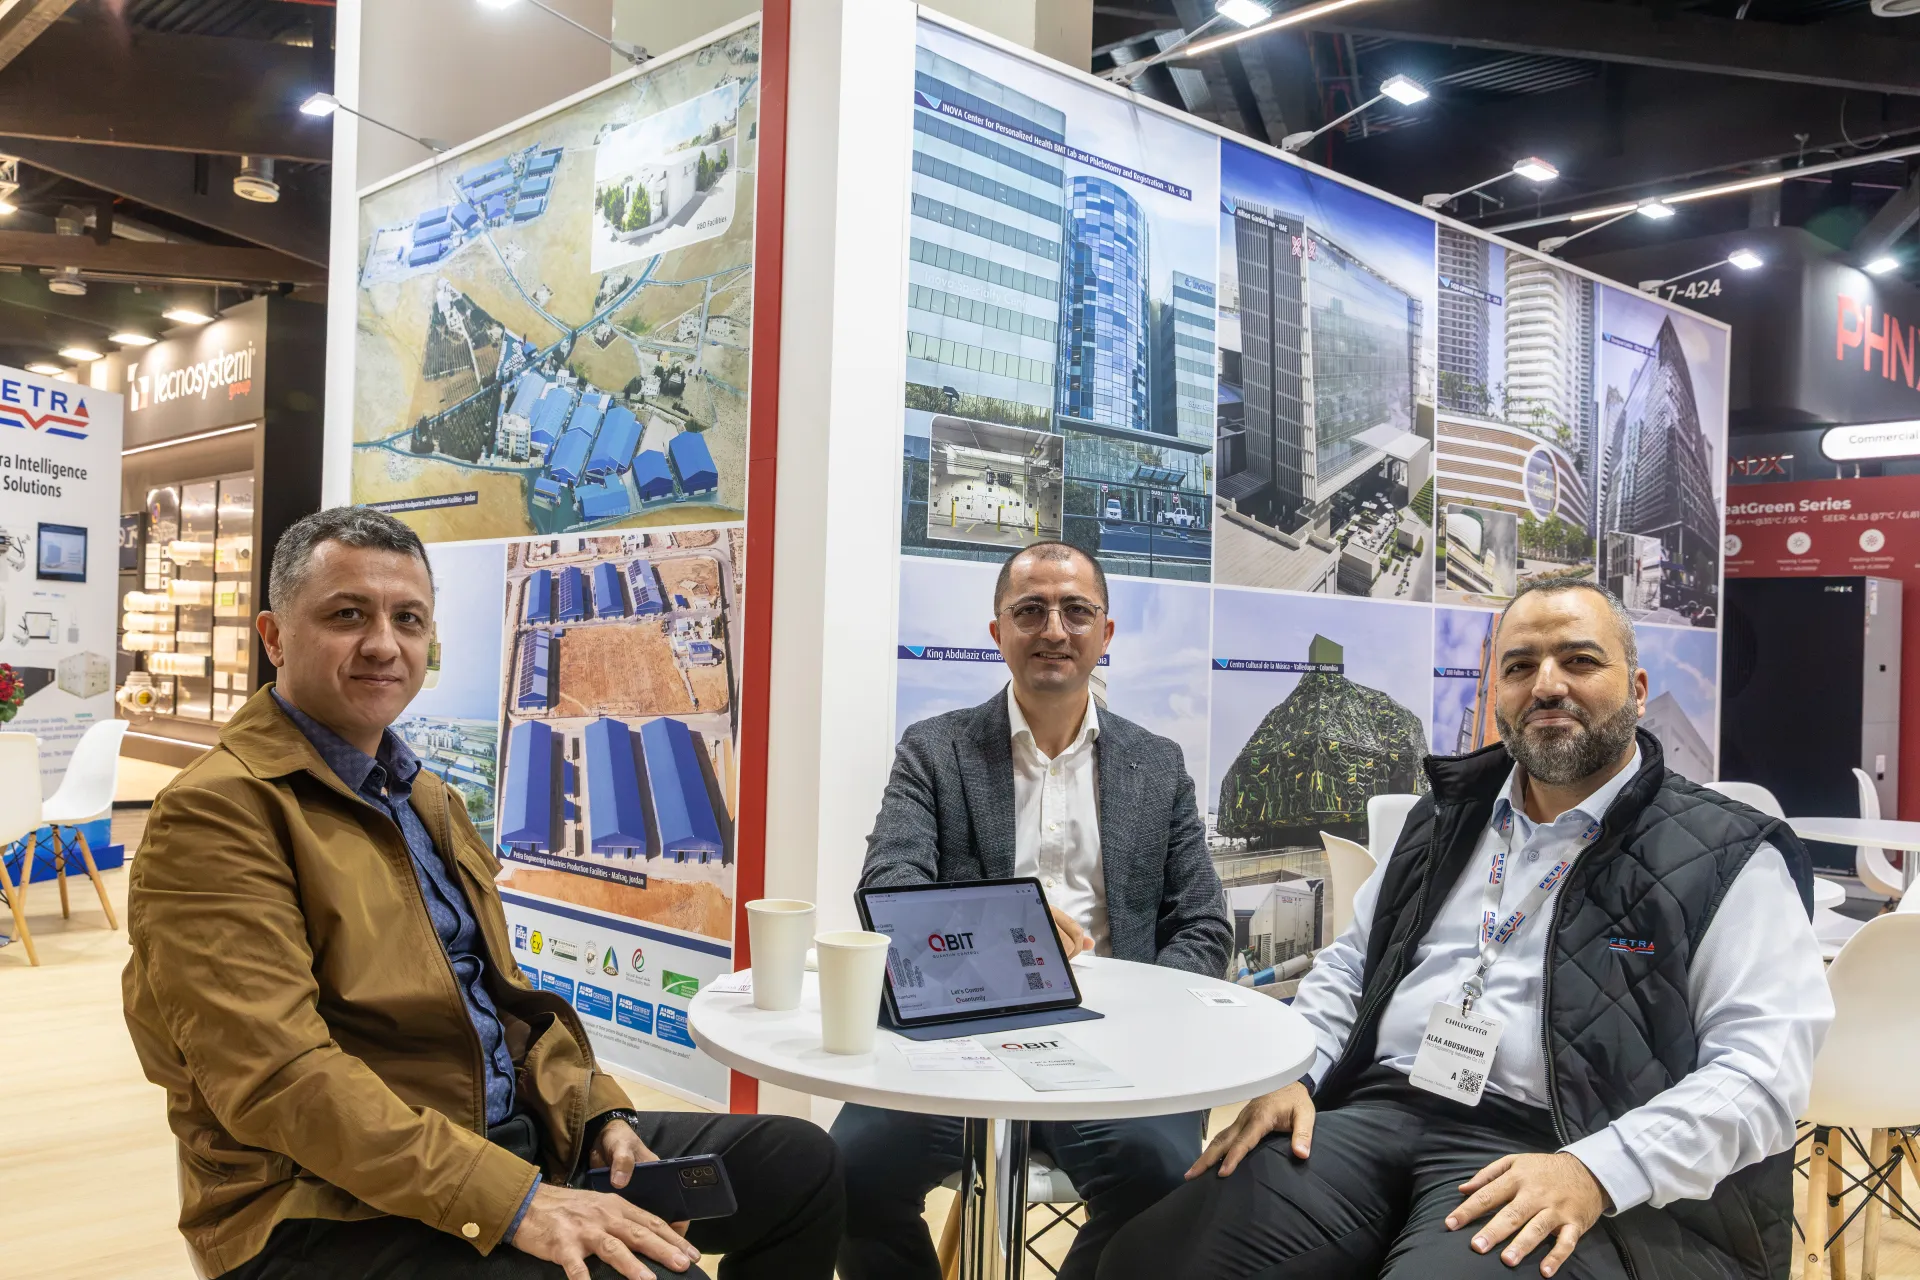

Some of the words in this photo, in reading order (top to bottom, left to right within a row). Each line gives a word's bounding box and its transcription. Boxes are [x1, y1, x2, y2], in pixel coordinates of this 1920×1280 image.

[942, 103, 963, 118] INOVA
[963, 111, 984, 126] Center
[985, 118, 994, 130] for
[995, 122, 1033, 143] Personalized
[1034, 135, 1053, 150] Health
[1054, 143, 1066, 155] BMT
[1067, 148, 1077, 159] Lab
[1078, 152, 1089, 163] and
[1090, 156, 1122, 176] Phlebotomy
[1122, 167, 1133, 179] and
[1133, 173, 1164, 190] Registration
[1167, 184, 1175, 193] VA
[1179, 188, 1190, 199] USA
[1666, 278, 1722, 302] 7-424
[1837, 293, 1920, 392] PHN
[1849, 431, 1919, 445] Commercial
[15, 454, 88, 480] Intelligence
[3, 475, 62, 498] Solutions
[1799, 496, 1852, 512] Series
[926, 648, 943, 661] King
[944, 649, 979, 660] Abdulaziz
[1229, 660, 1245, 669] Centro
[1246, 661, 1263, 669] Cultural
[1263, 661, 1270, 669] de
[1270, 661, 1275, 669] la
[1319, 664, 1339, 672] Colombia
[513, 850, 523, 860] Petra
[523, 852, 547, 867] Engineering
[546, 857, 566, 869] Industries
[566, 861, 589, 874] Production
[589, 866, 608, 878] Facilities
[628, 874, 644, 885] Jordan
[1494, 853, 1505, 885] PETRA
[1539, 861, 1568, 889] PETRA
[1494, 911, 1523, 943] PETRA
[928, 931, 974, 952] QBIT
[1609, 937, 1655, 949] PETRA
[523, 970, 537, 980] ERTIFIED
[555, 979, 571, 989] CERTIFIED
[950, 987, 964, 996] Let's
[964, 986, 985, 995] Control
[592, 991, 611, 1003] CERTIFIED
[633, 1005, 650, 1016] CERTIFIED
[1001, 1040, 1058, 1050] QBIT
[1426, 1033, 1442, 1044] ALAA
[1443, 1039, 1485, 1058] ABUSHAWISH
[1451, 1072, 1457, 1081] A
